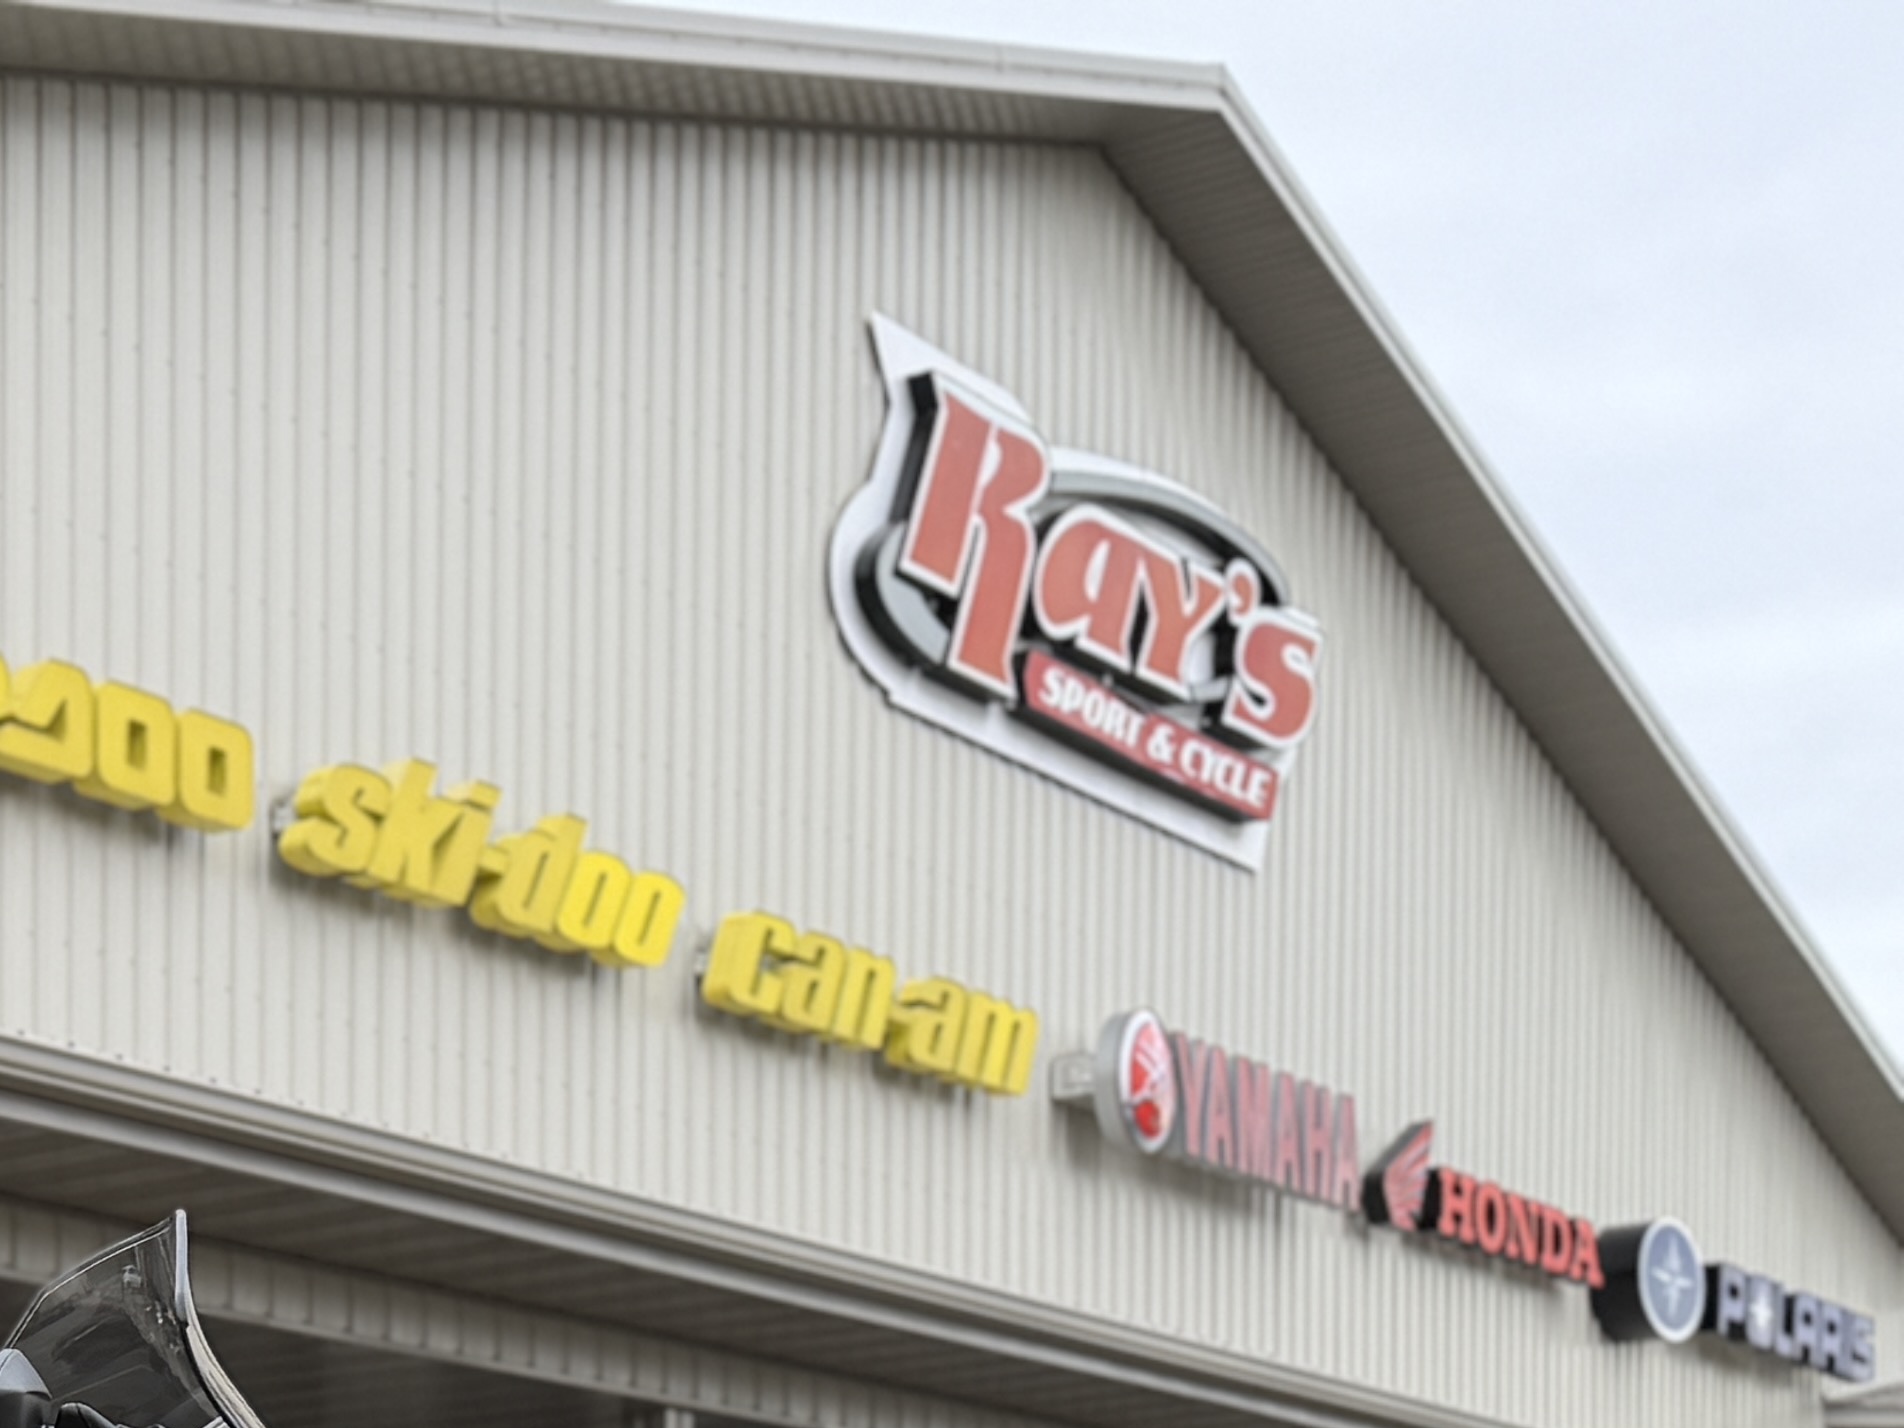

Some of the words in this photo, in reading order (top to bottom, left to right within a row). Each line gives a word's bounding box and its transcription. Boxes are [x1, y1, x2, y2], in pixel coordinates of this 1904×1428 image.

[899, 369, 1323, 746] Ray's
[1037, 664, 1146, 749] SPORT
[1147, 719, 1176, 764] &
[1179, 737, 1276, 809] CYCLE
[1170, 1030, 1361, 1211] YAMAHA
[1432, 1166, 1605, 1287] HONDA
[1710, 1262, 1876, 1382] POLARIS
